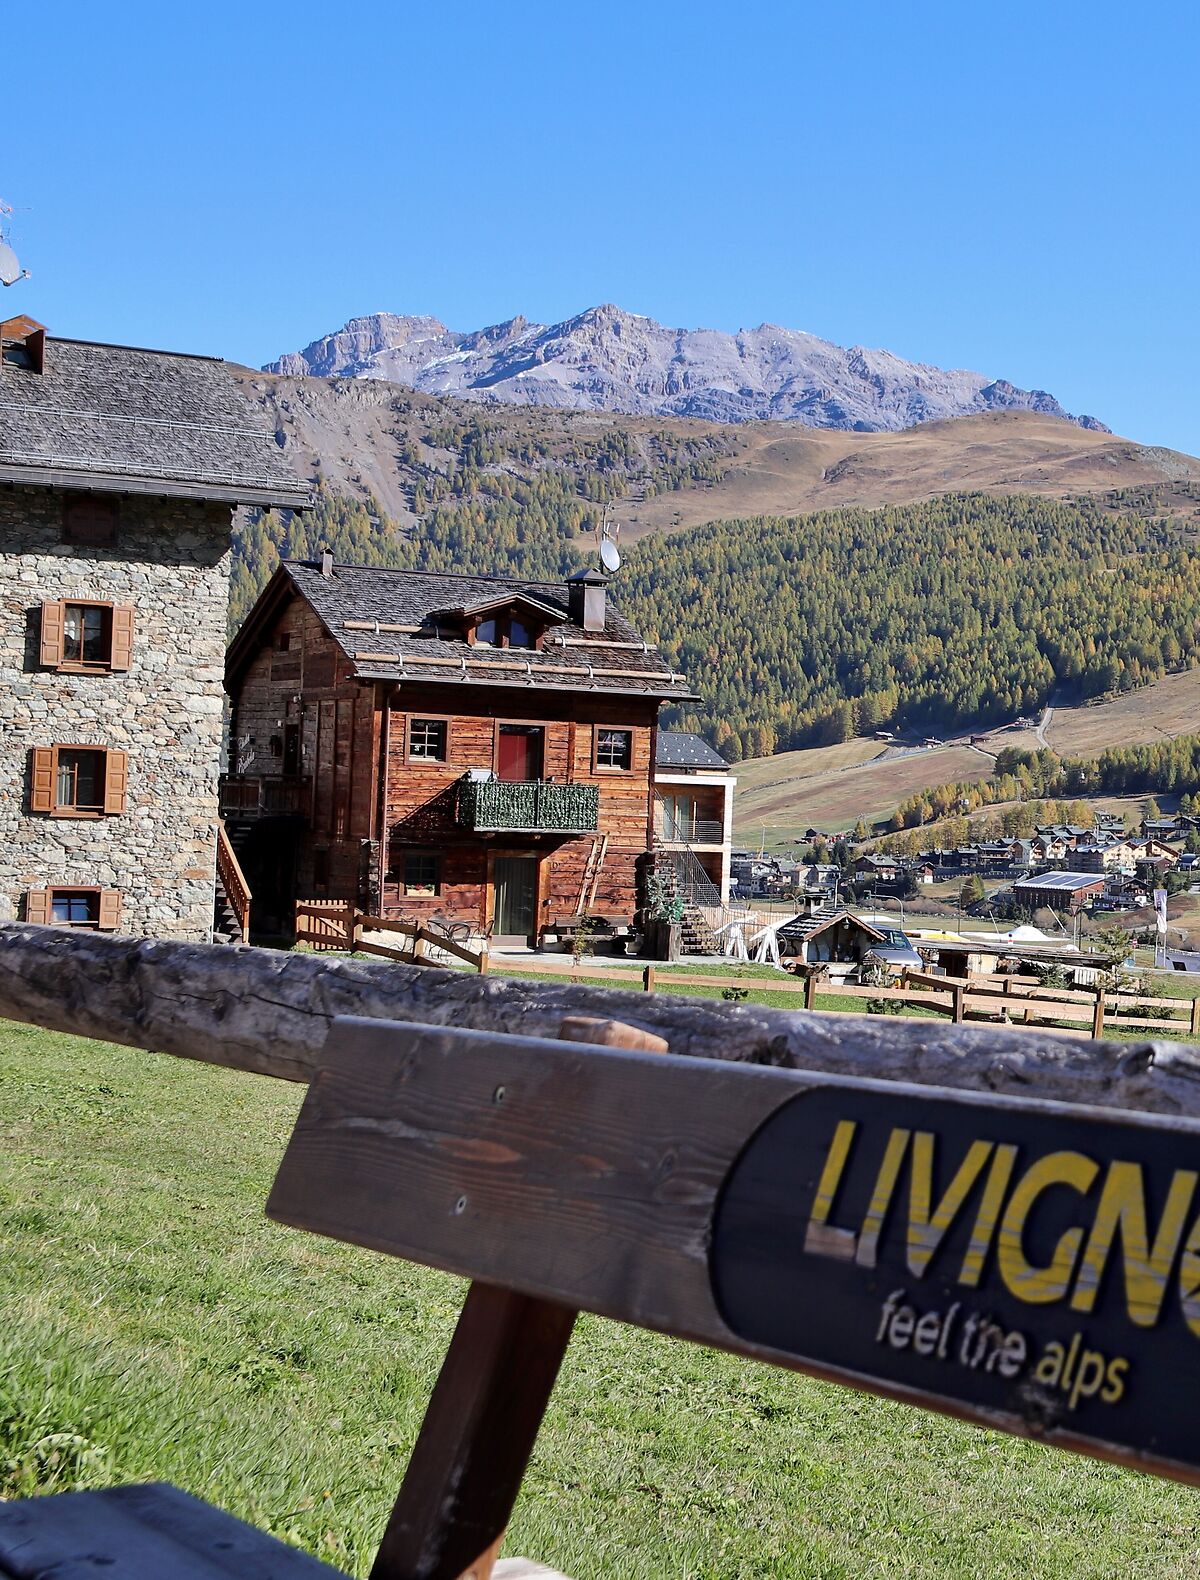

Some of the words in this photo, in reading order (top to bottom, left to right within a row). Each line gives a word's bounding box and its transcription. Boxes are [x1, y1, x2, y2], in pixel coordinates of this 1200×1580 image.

[876, 1288, 961, 1359] feel
[960, 1311, 1027, 1377] the
[1035, 1331, 1129, 1410] alps
